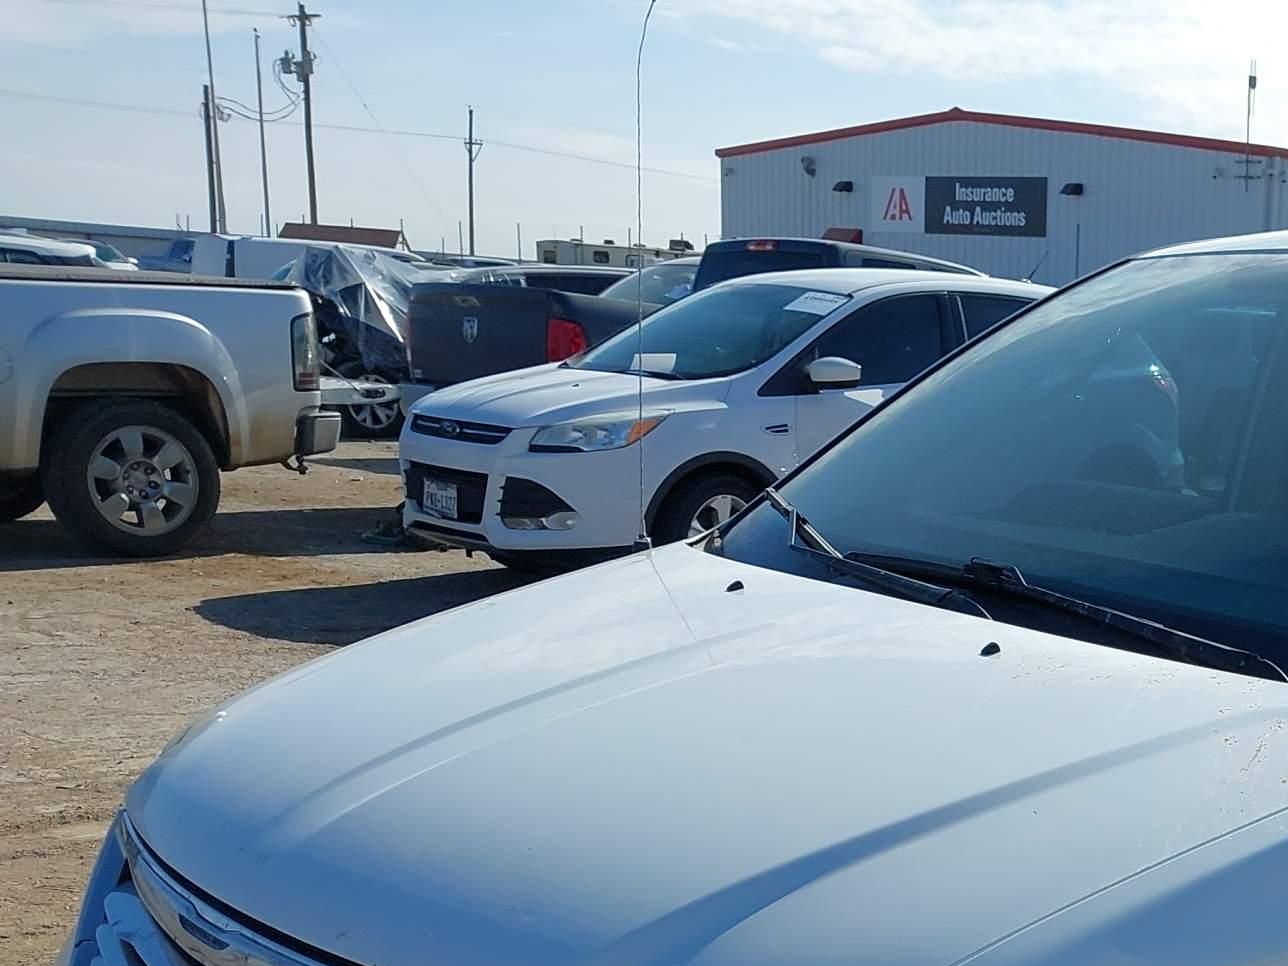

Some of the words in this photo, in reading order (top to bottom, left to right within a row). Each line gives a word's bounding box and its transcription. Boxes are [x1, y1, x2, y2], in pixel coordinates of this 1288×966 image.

[955, 182, 1015, 203] Insurance
[943, 205, 971, 225] Auto
[973, 206, 1027, 227] Auctions
